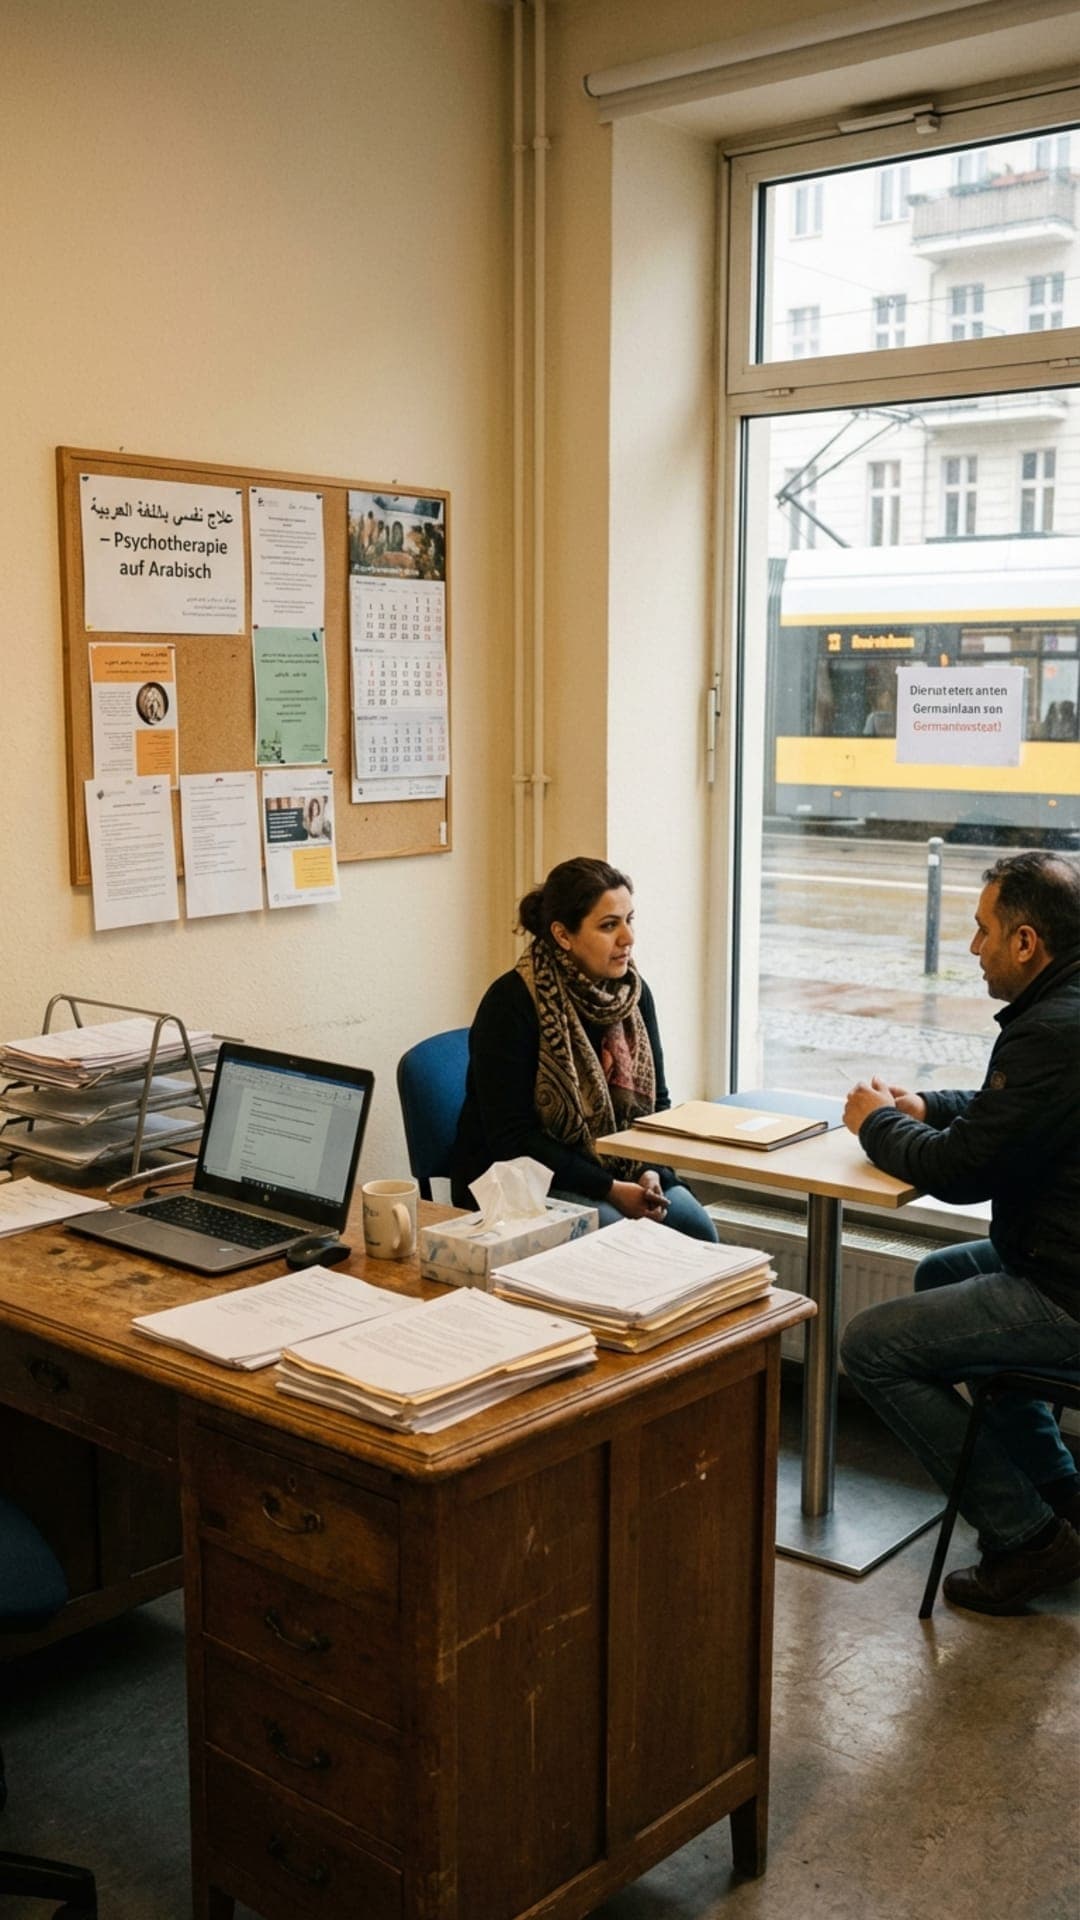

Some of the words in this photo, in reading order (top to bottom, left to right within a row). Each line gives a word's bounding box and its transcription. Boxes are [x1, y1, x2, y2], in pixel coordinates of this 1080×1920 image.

[208, 510, 234, 530] علاج
[113, 531, 228, 557] Psychotherapie
[119, 559, 146, 577] auf
[148, 560, 212, 579] Arabisch
